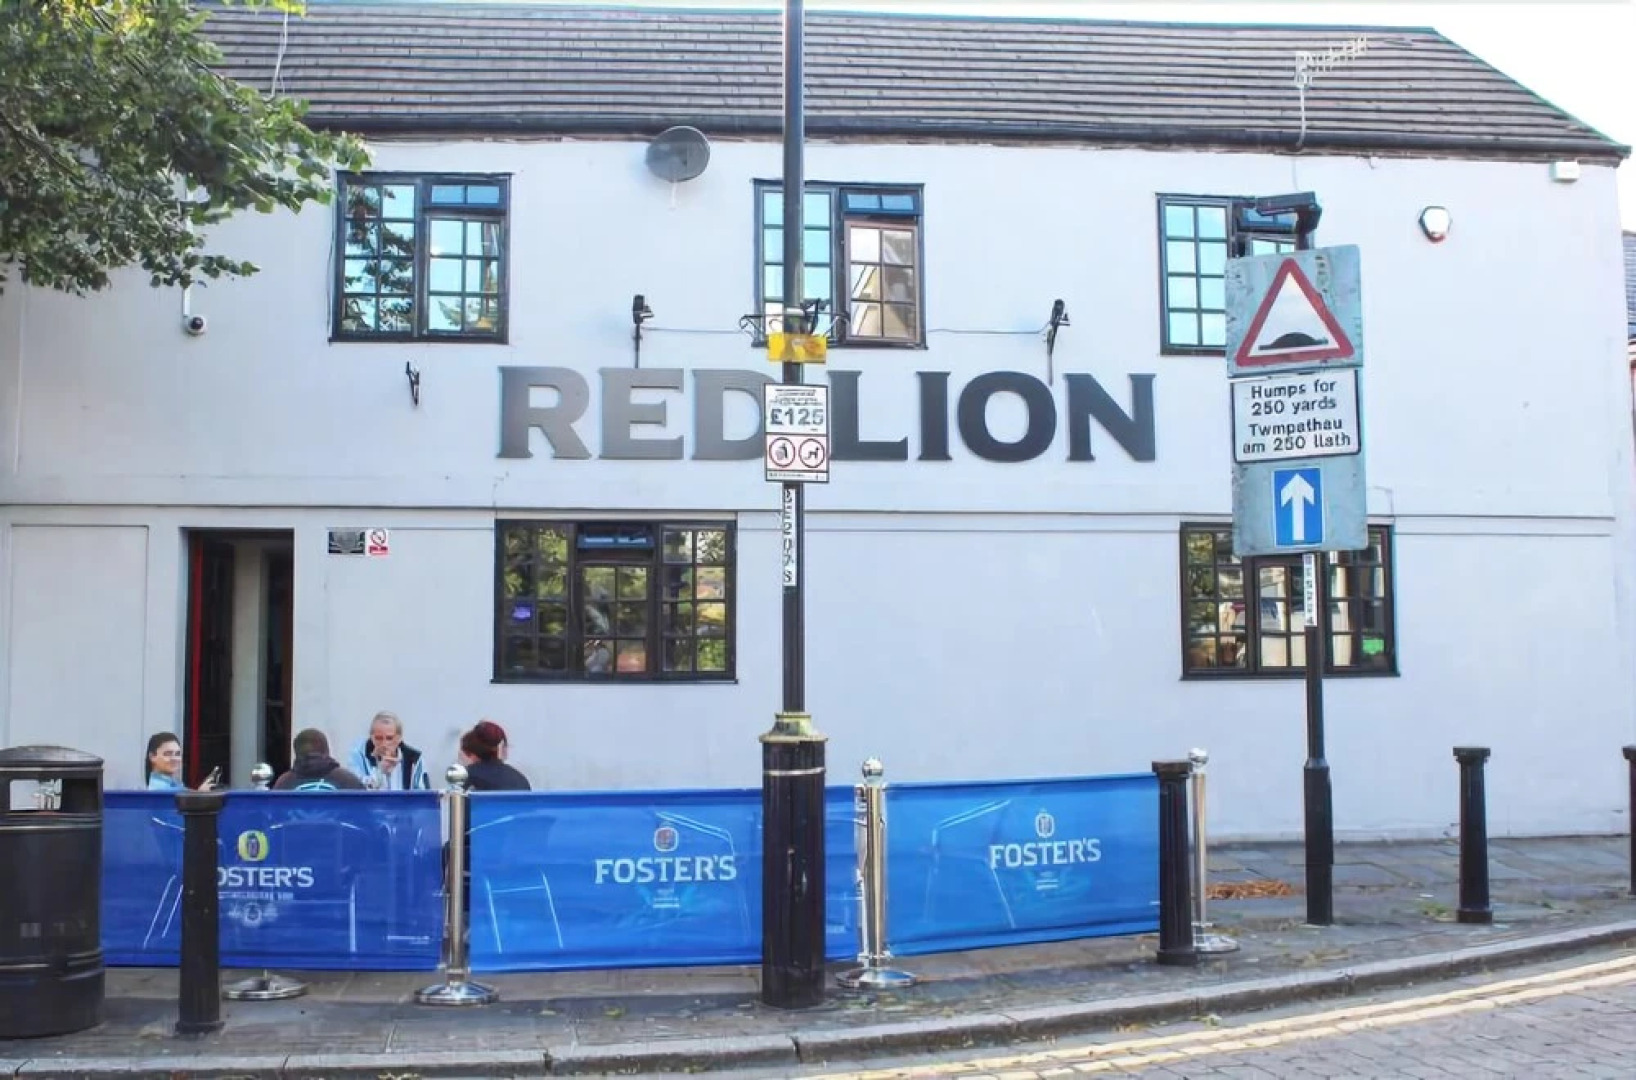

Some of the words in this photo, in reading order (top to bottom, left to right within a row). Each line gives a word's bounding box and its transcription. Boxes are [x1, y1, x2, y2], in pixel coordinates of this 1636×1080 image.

[1251, 384, 1306, 398] Humps
[1314, 379, 1337, 393] for
[496, 366, 777, 461] RED
[826, 369, 1157, 463] LION
[769, 408, 824, 426] £125
[1251, 399, 1285, 416] 250
[1292, 396, 1337, 415] yards
[1248, 417, 1343, 437] Twmpathau
[1243, 443, 1265, 454] am
[1273, 436, 1306, 452] 250
[1314, 432, 1351, 448] llath
[989, 838, 1102, 870] FOSTER'S
[217, 866, 315, 888] STER'S
[595, 855, 737, 884] FOSTER'S
